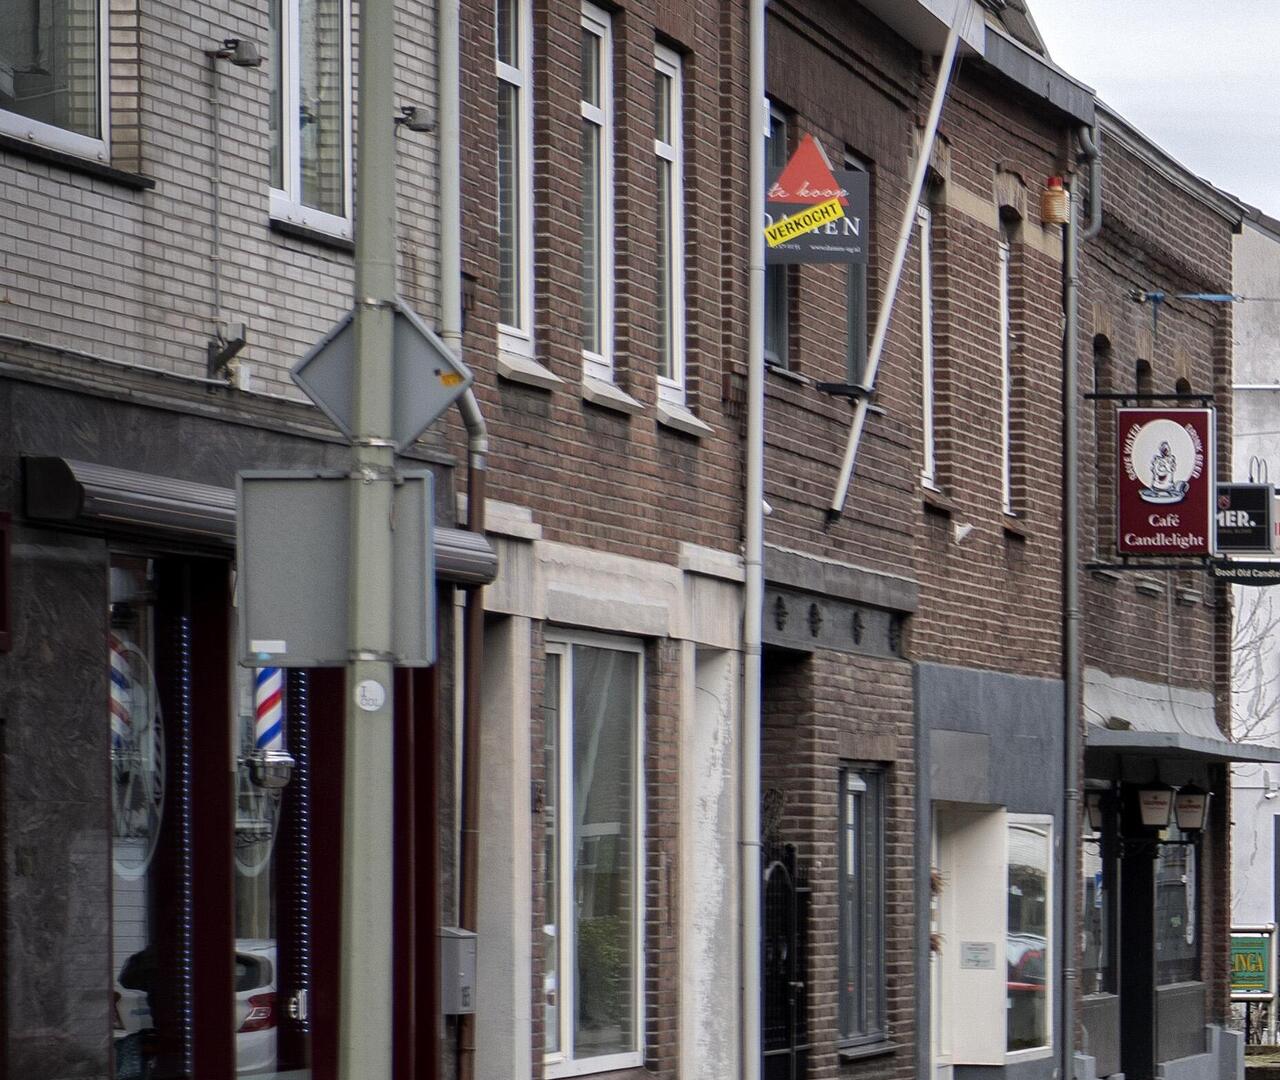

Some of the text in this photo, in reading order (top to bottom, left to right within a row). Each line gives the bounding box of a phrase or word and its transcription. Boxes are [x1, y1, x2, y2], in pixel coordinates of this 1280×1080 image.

[767, 202, 839, 241] VERKOCHT
[1147, 513, 1181, 527] Café
[1124, 533, 1205, 550] Candlelight
[1237, 569, 1252, 578] Old
